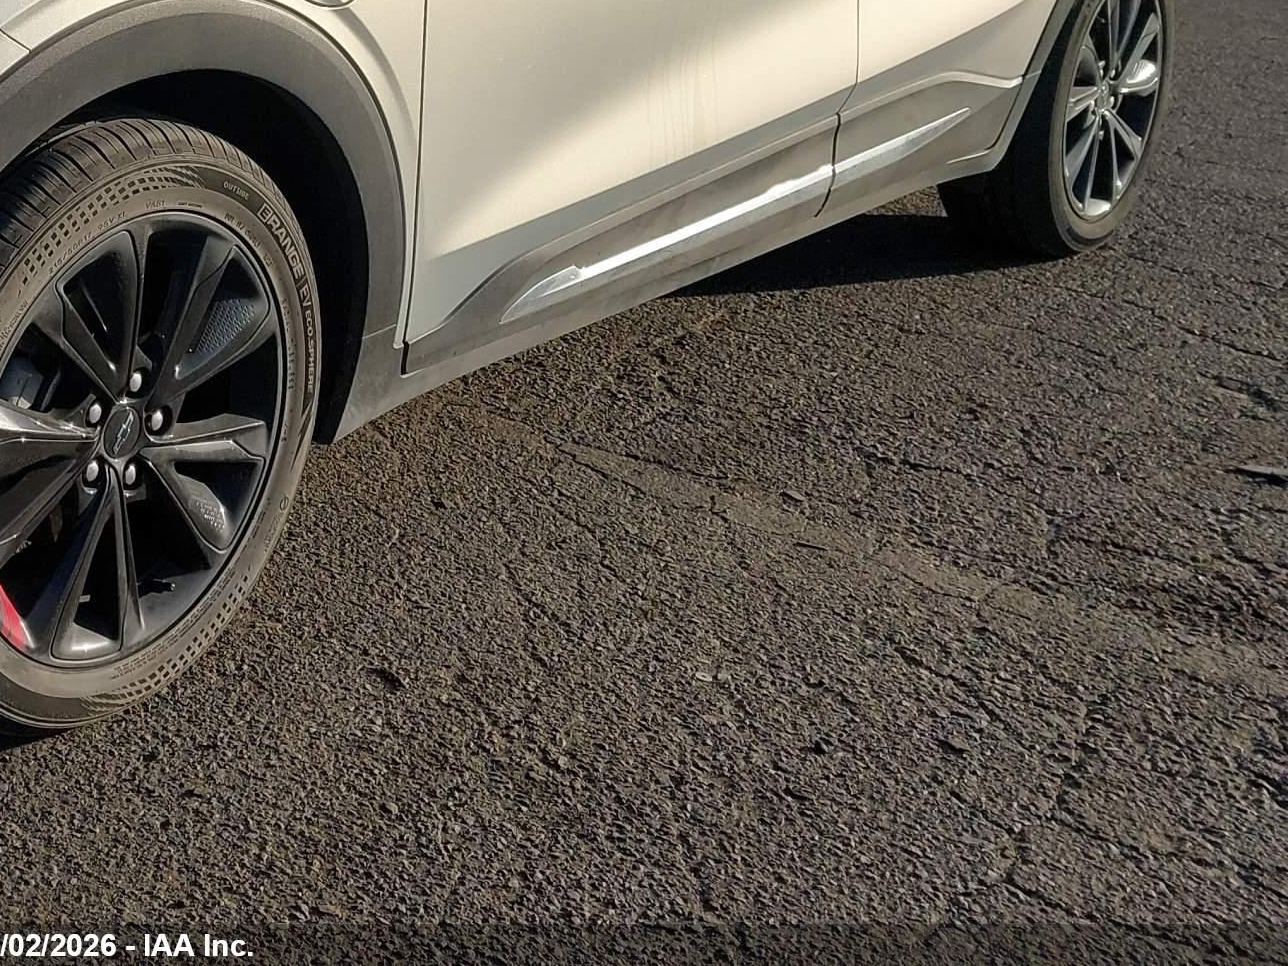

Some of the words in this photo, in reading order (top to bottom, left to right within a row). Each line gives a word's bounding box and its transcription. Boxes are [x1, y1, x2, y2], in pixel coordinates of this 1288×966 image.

[223, 181, 251, 201] OUTSIDE
[257, 202, 304, 280] ERANGE
[299, 284, 312, 307] EV
